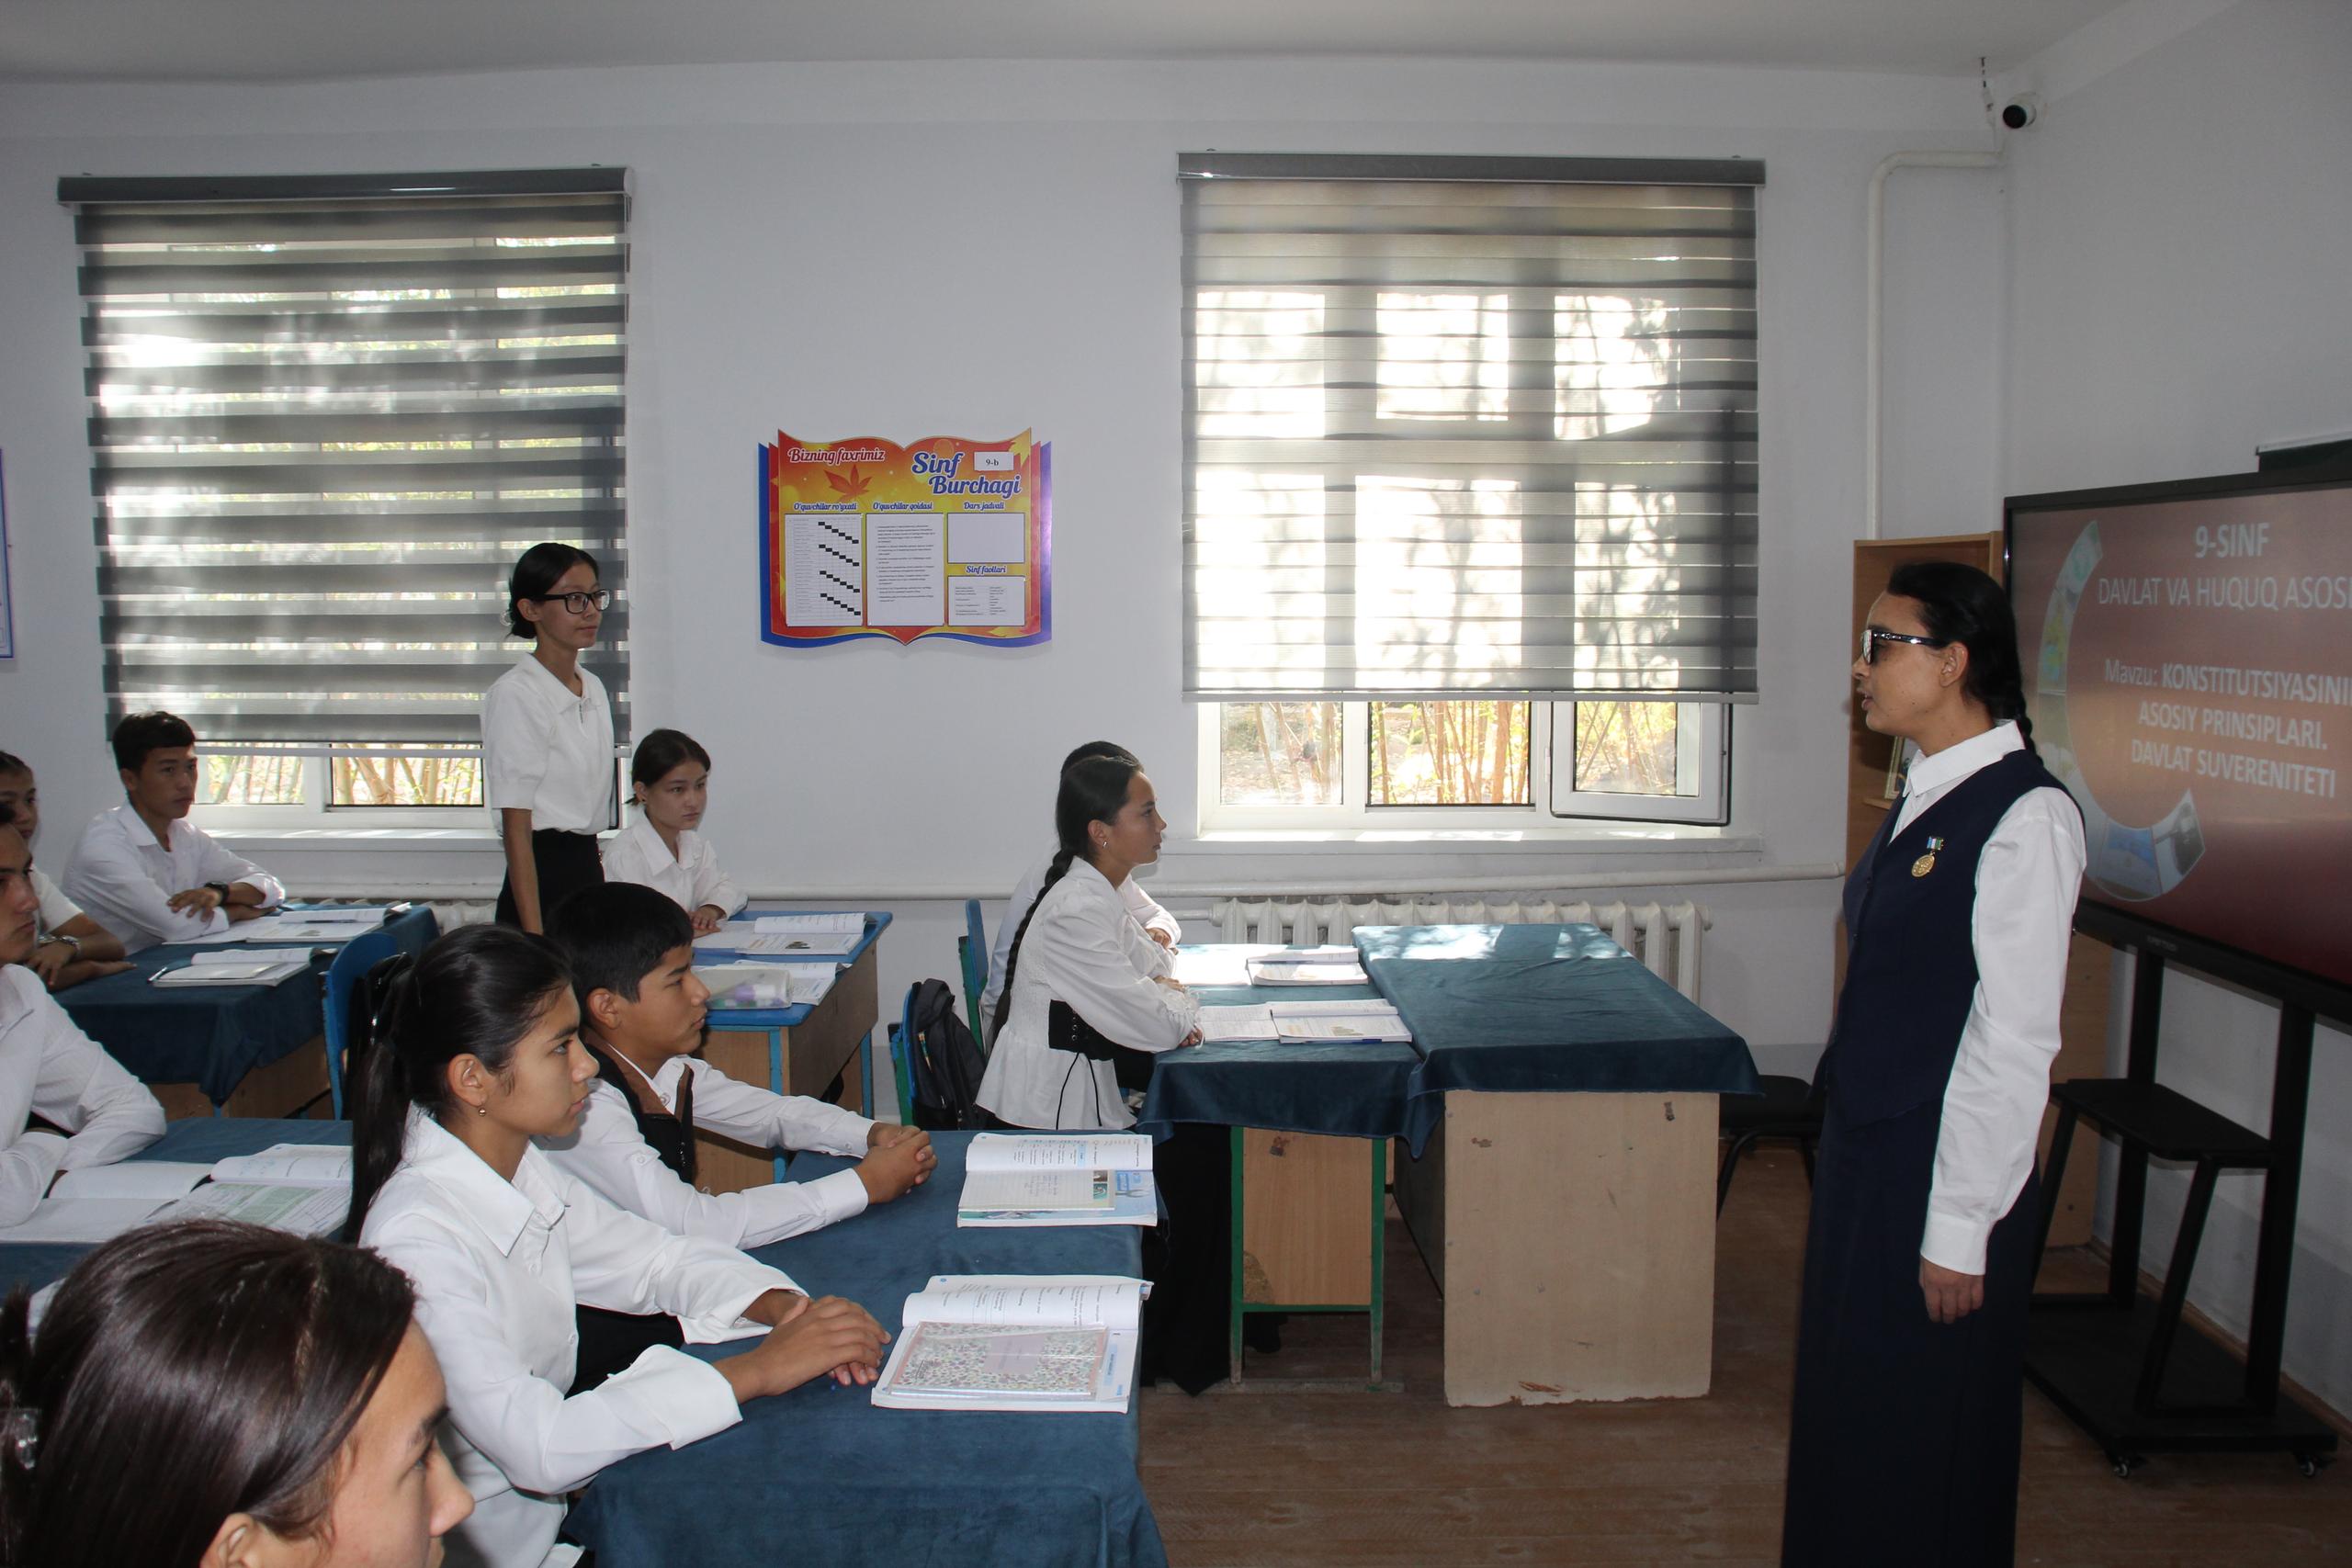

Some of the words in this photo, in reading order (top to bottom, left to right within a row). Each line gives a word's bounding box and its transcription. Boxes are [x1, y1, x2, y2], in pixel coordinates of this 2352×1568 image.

[787, 447, 835, 466] Bizning
[835, 447, 885, 466] faxrimiz
[911, 451, 965, 479] Sinf
[985, 458, 1000, 467] 9-b
[928, 475, 1023, 500] Burchagi
[964, 502, 980, 510] Dars
[979, 502, 1004, 512] jadvali
[2195, 523, 2271, 558] 9-SINF
[966, 565, 981, 575] Sinf
[981, 565, 1007, 575] faollari
[2098, 577, 2163, 606] DAVLAT
[2165, 577, 2191, 607] VA
[2197, 576, 2279, 612] HUQUQ
[2104, 658, 2159, 687] Mavzu:
[2162, 662, 2352, 706] KONSTITUTSIYASINI
[2138, 700, 2199, 732] ASOSIY
[2202, 707, 2329, 750] PRINSIPLARI.
[2132, 738, 2194, 773] DAVLAT
[2197, 748, 2337, 799] SUVERENITETI
